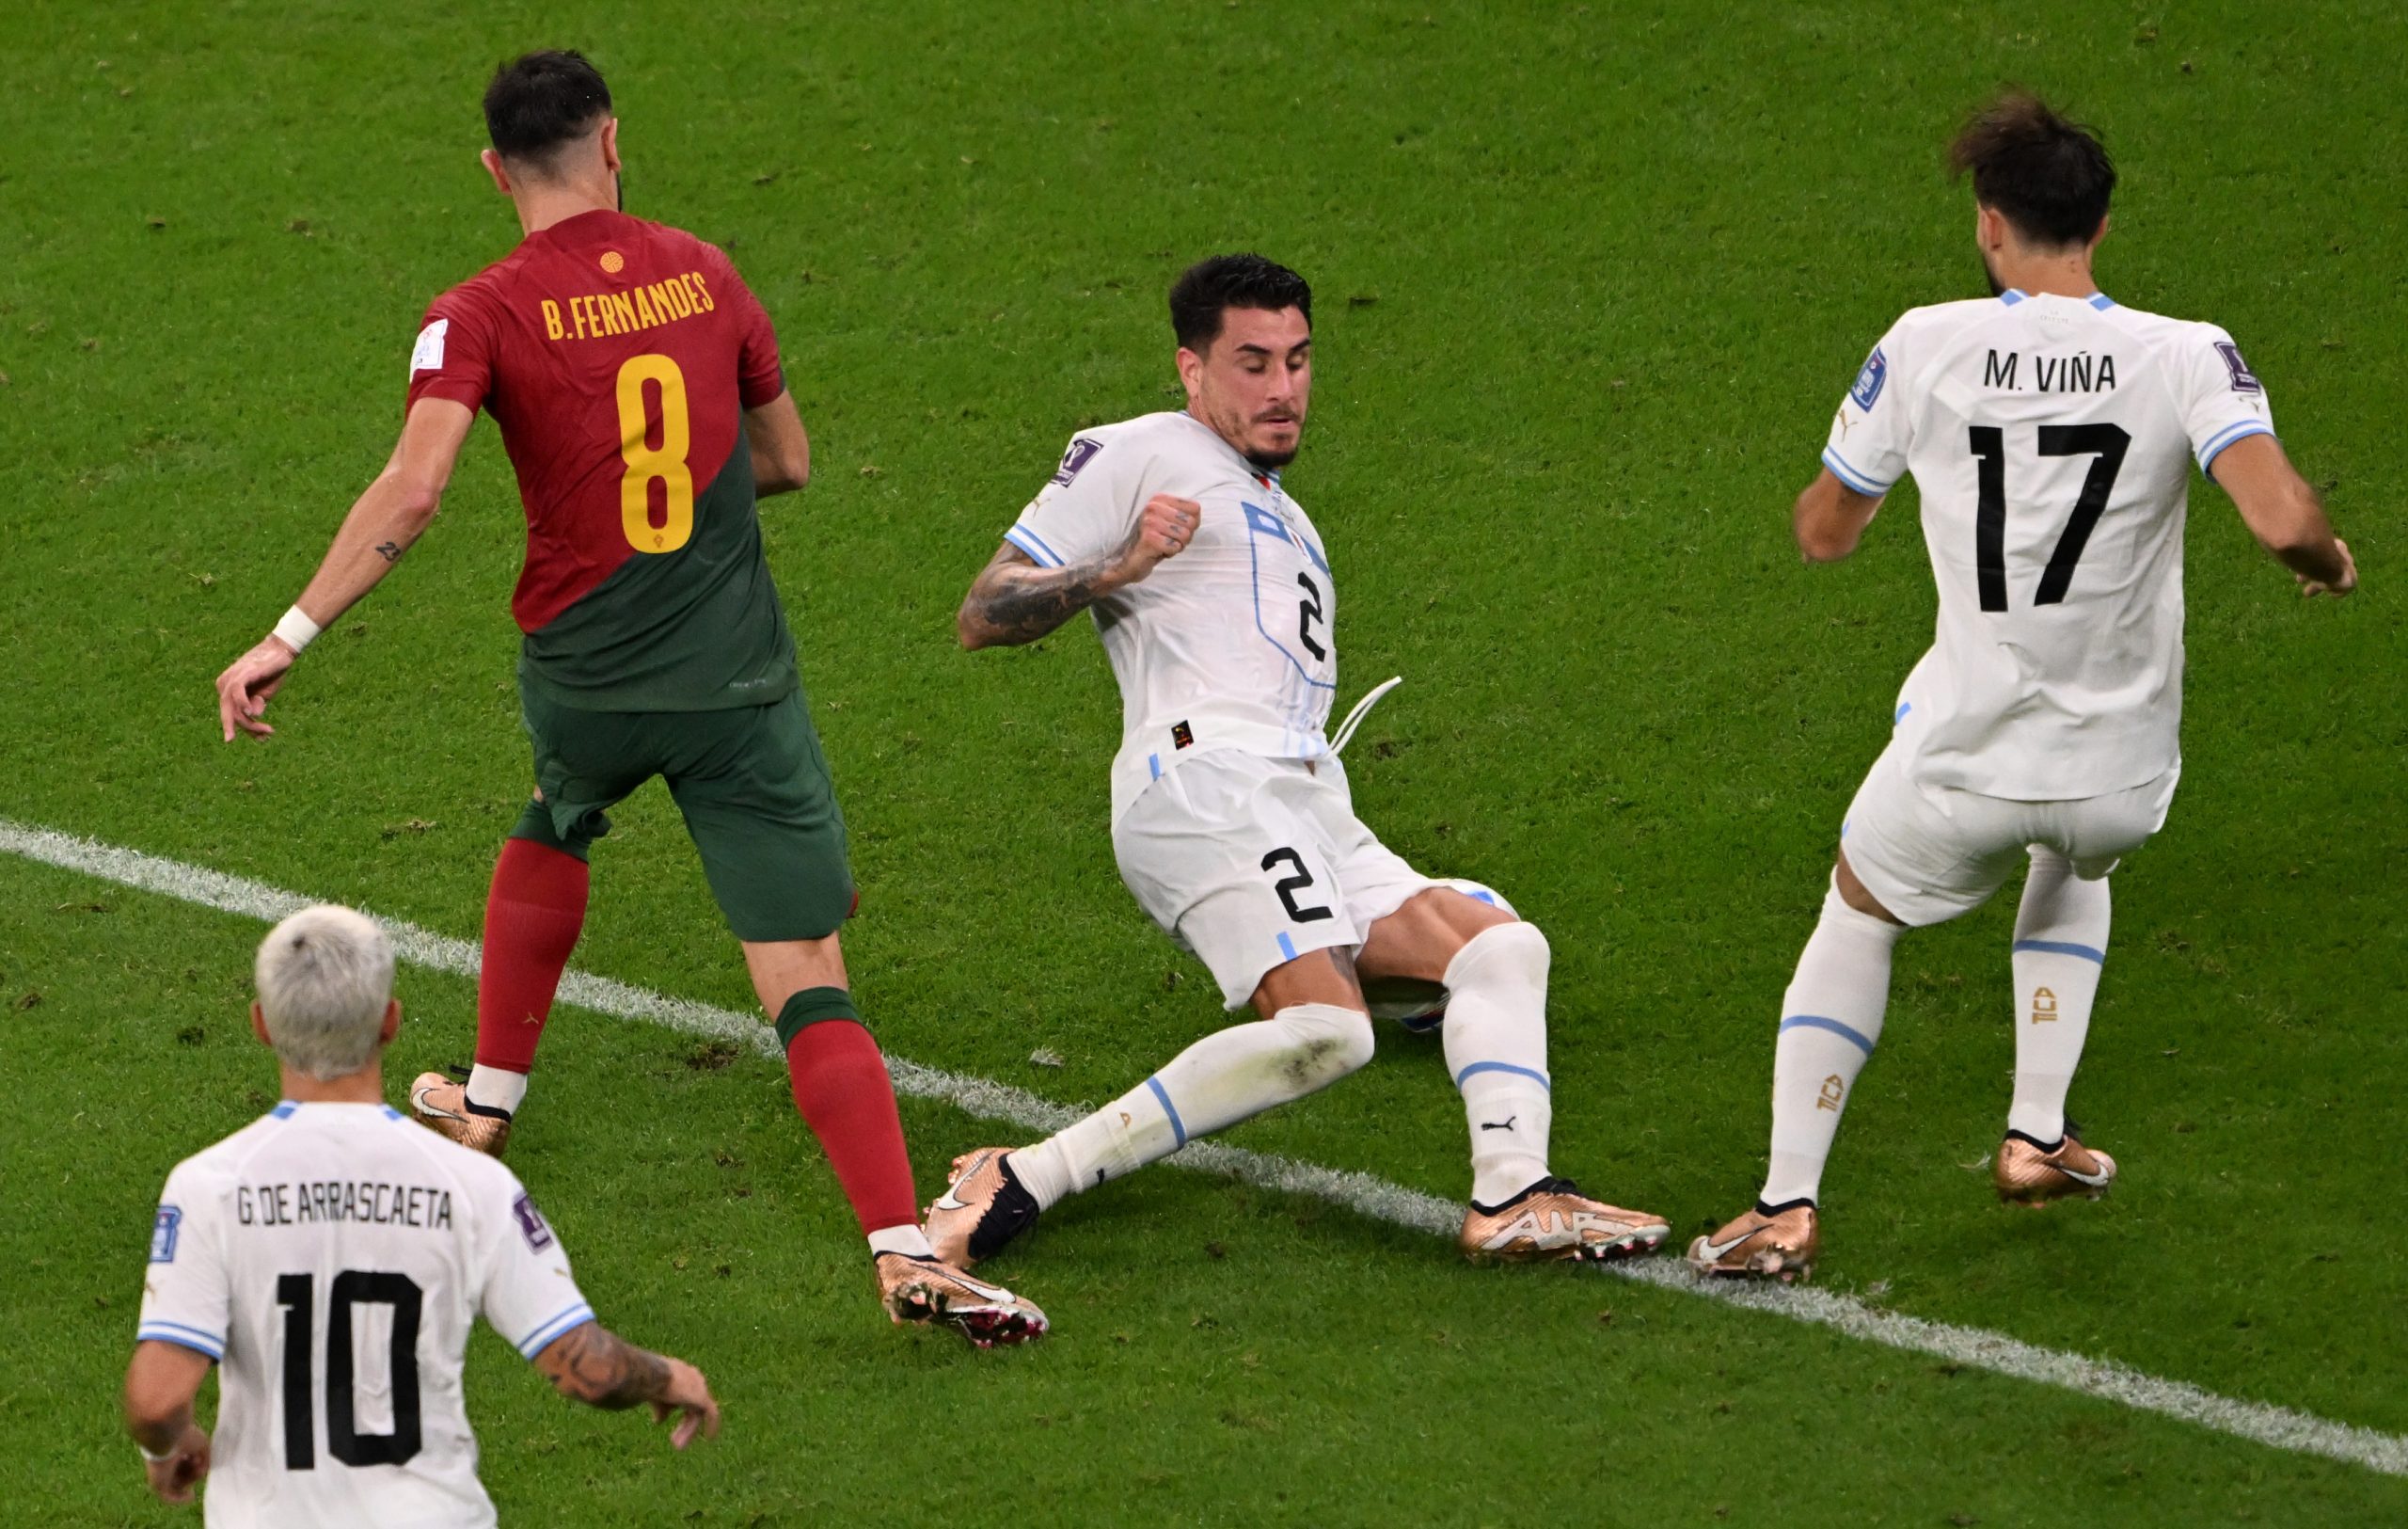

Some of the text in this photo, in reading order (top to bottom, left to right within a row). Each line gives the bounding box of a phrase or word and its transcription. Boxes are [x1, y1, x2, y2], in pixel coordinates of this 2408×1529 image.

[540, 270, 716, 342] B.FERNANDES
[1983, 348, 2117, 394] M. VIÑA
[614, 353, 695, 555] 8
[1968, 422, 2132, 613] 17
[1296, 570, 1327, 664] 2
[1259, 846, 1335, 924] 2
[297, 1180, 453, 1231] ARRASCAETA
[276, 1268, 424, 1472] 10
